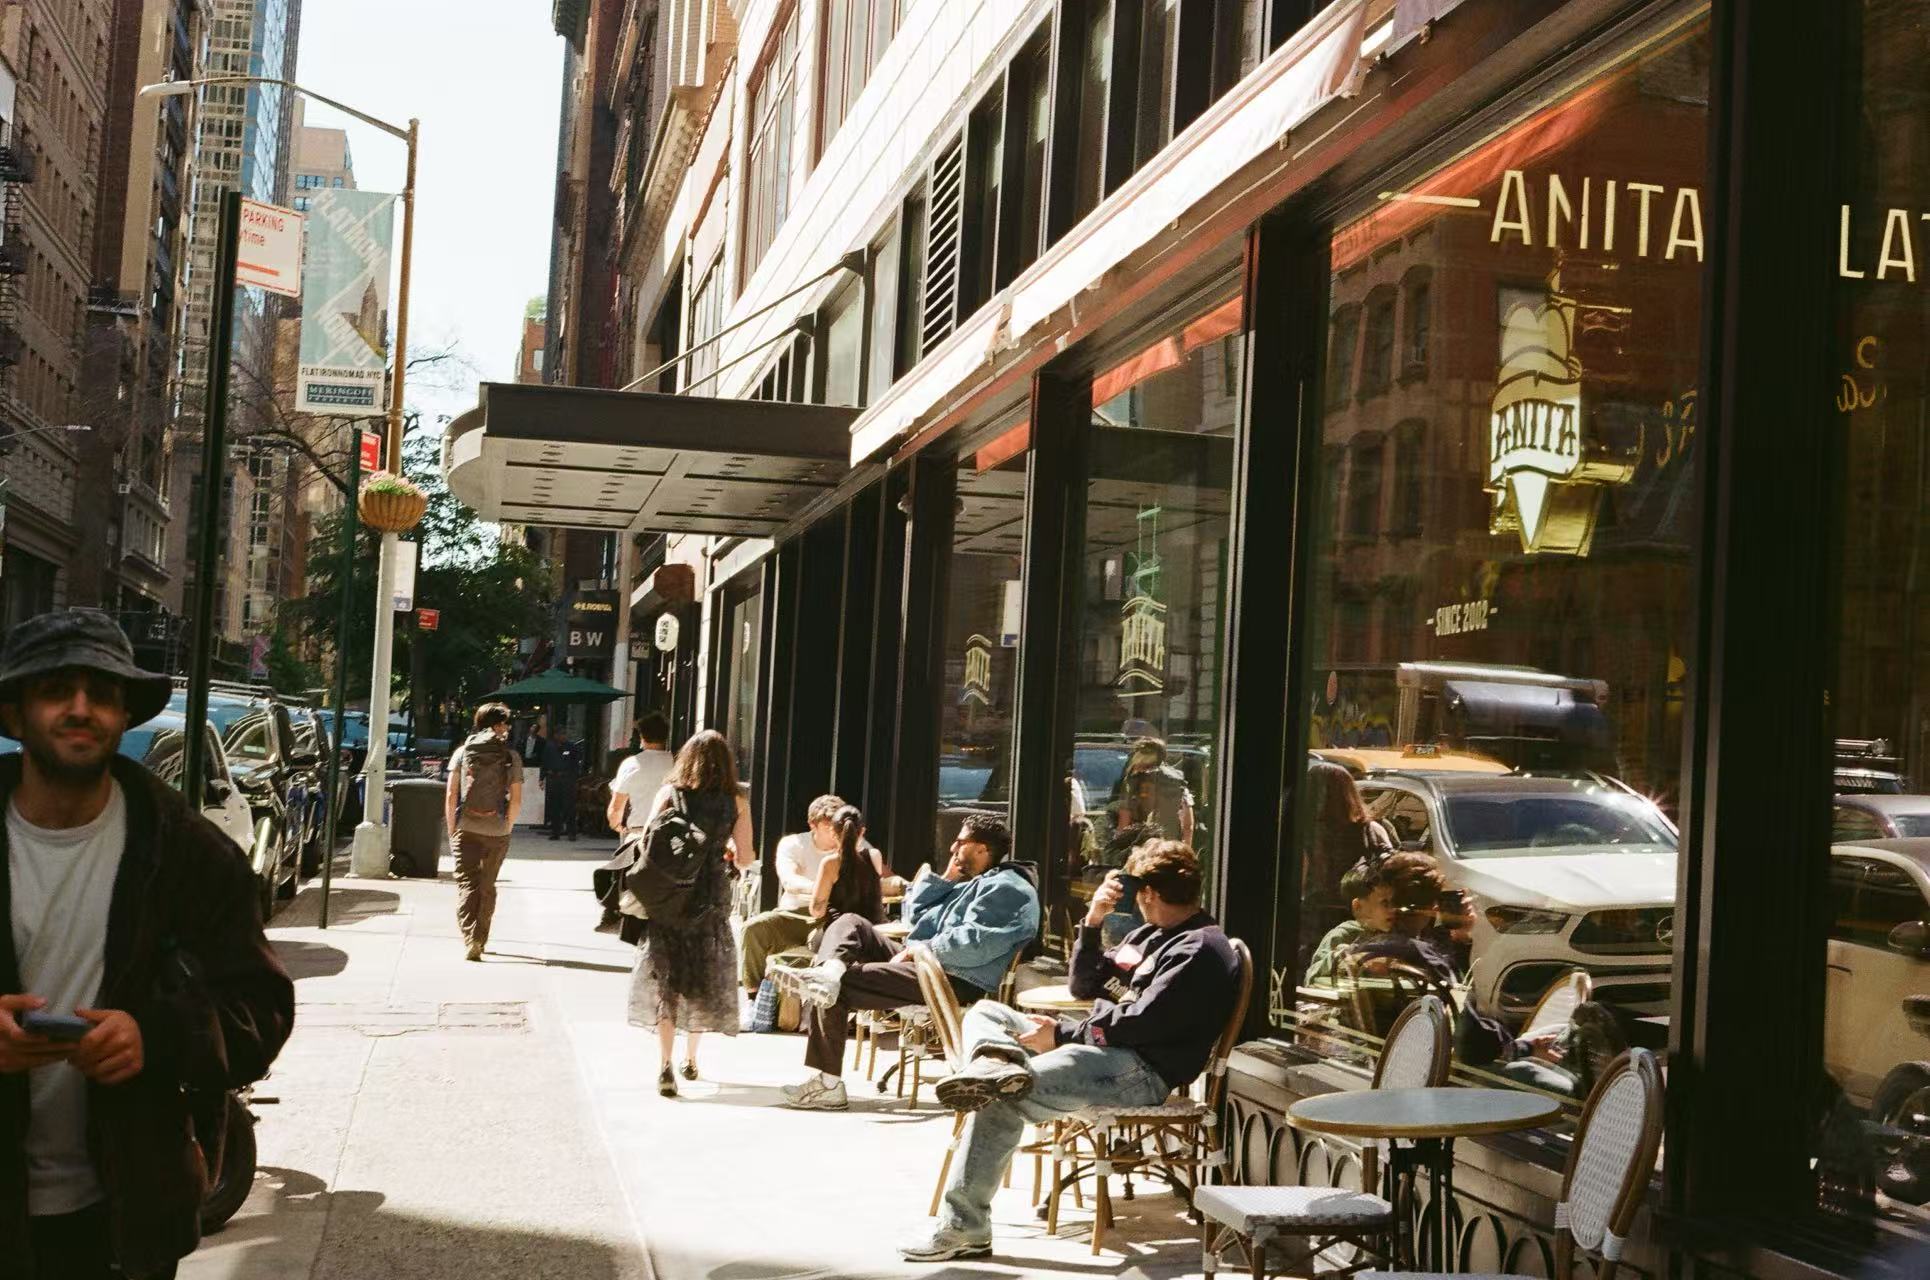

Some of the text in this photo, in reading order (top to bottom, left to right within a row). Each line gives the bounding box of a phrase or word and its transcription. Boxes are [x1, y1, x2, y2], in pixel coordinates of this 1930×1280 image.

[243, 208, 284, 233] PARKING
[1490, 169, 1703, 263] ANITA
[1491, 400, 1576, 463] ANITA
[1436, 600, 1488, 636] SINCE 2002
